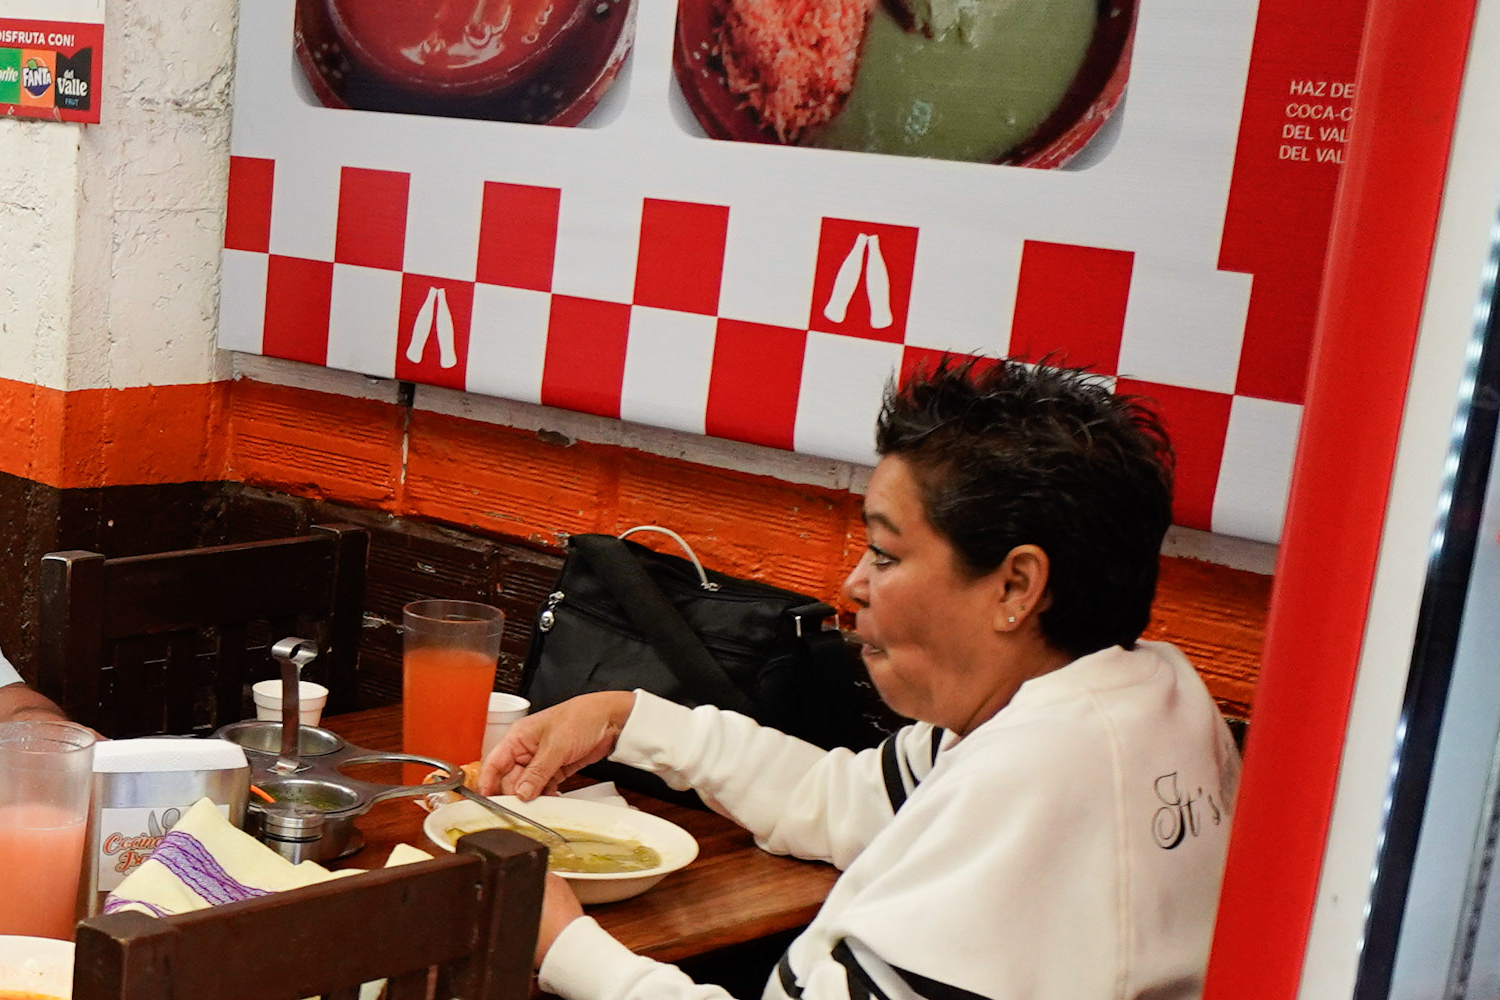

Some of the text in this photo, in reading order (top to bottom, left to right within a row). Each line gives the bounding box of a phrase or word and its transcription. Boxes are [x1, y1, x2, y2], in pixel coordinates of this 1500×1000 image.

[48, 34, 75, 47] CON!
[22, 65, 53, 87] FANTA
[64, 69, 74, 79] del
[57, 77, 88, 96] Valle
[1290, 80, 1357, 99] HAZ DE
[1285, 103, 1355, 121] COCA-C
[1282, 124, 1349, 143] DEL VAL
[1279, 144, 1346, 164] DEL VAL
